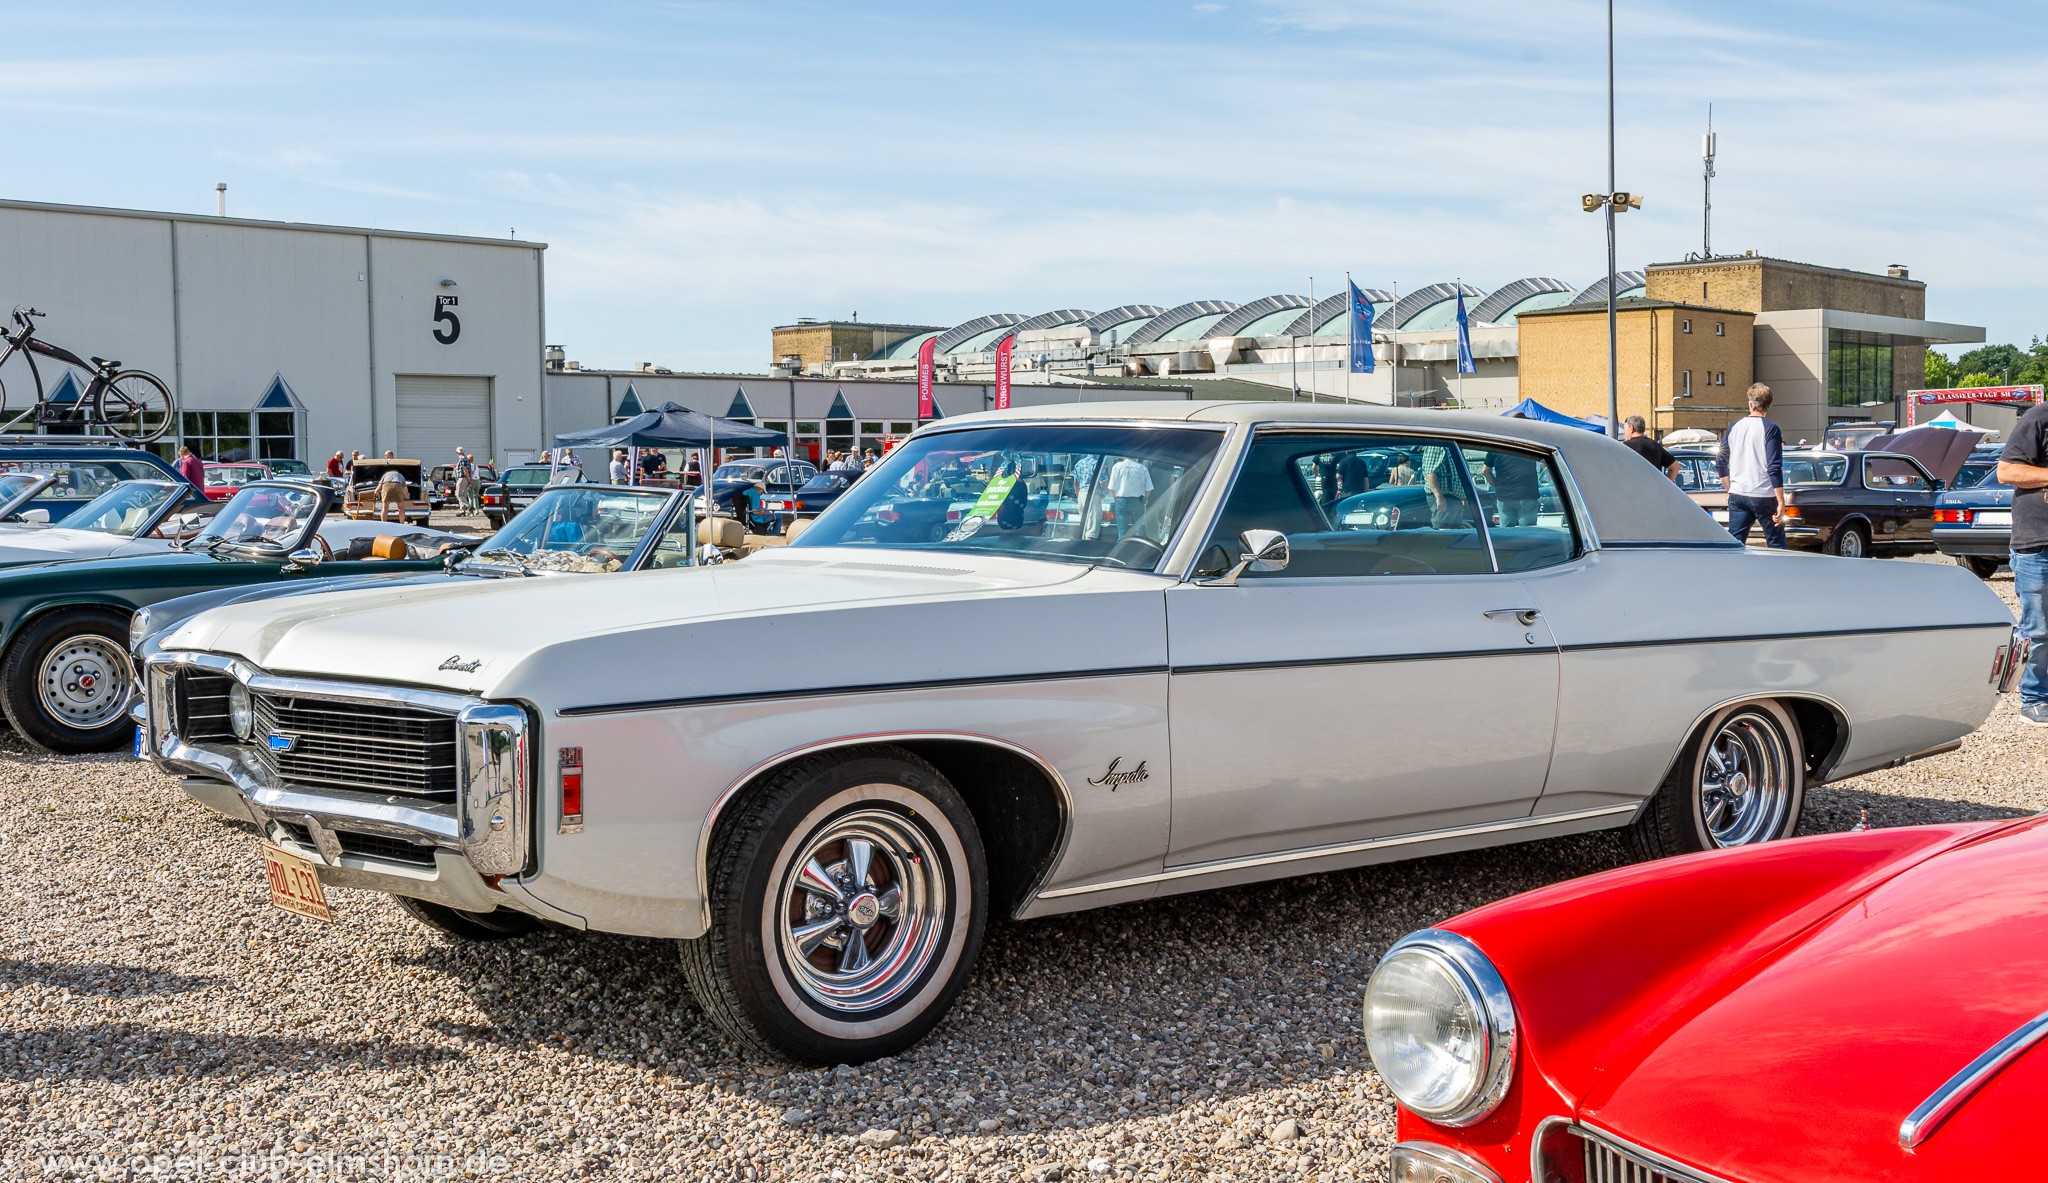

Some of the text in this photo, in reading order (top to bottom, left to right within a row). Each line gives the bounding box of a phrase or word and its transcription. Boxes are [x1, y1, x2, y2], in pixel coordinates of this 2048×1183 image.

[438, 296, 456, 305] Tor 1
[432, 294, 461, 345] 5
[921, 363, 930, 401] POMMES
[999, 351, 1008, 408] CURRYWURST
[2000, 391, 2012, 399] SH
[1087, 756, 1149, 792] Impala
